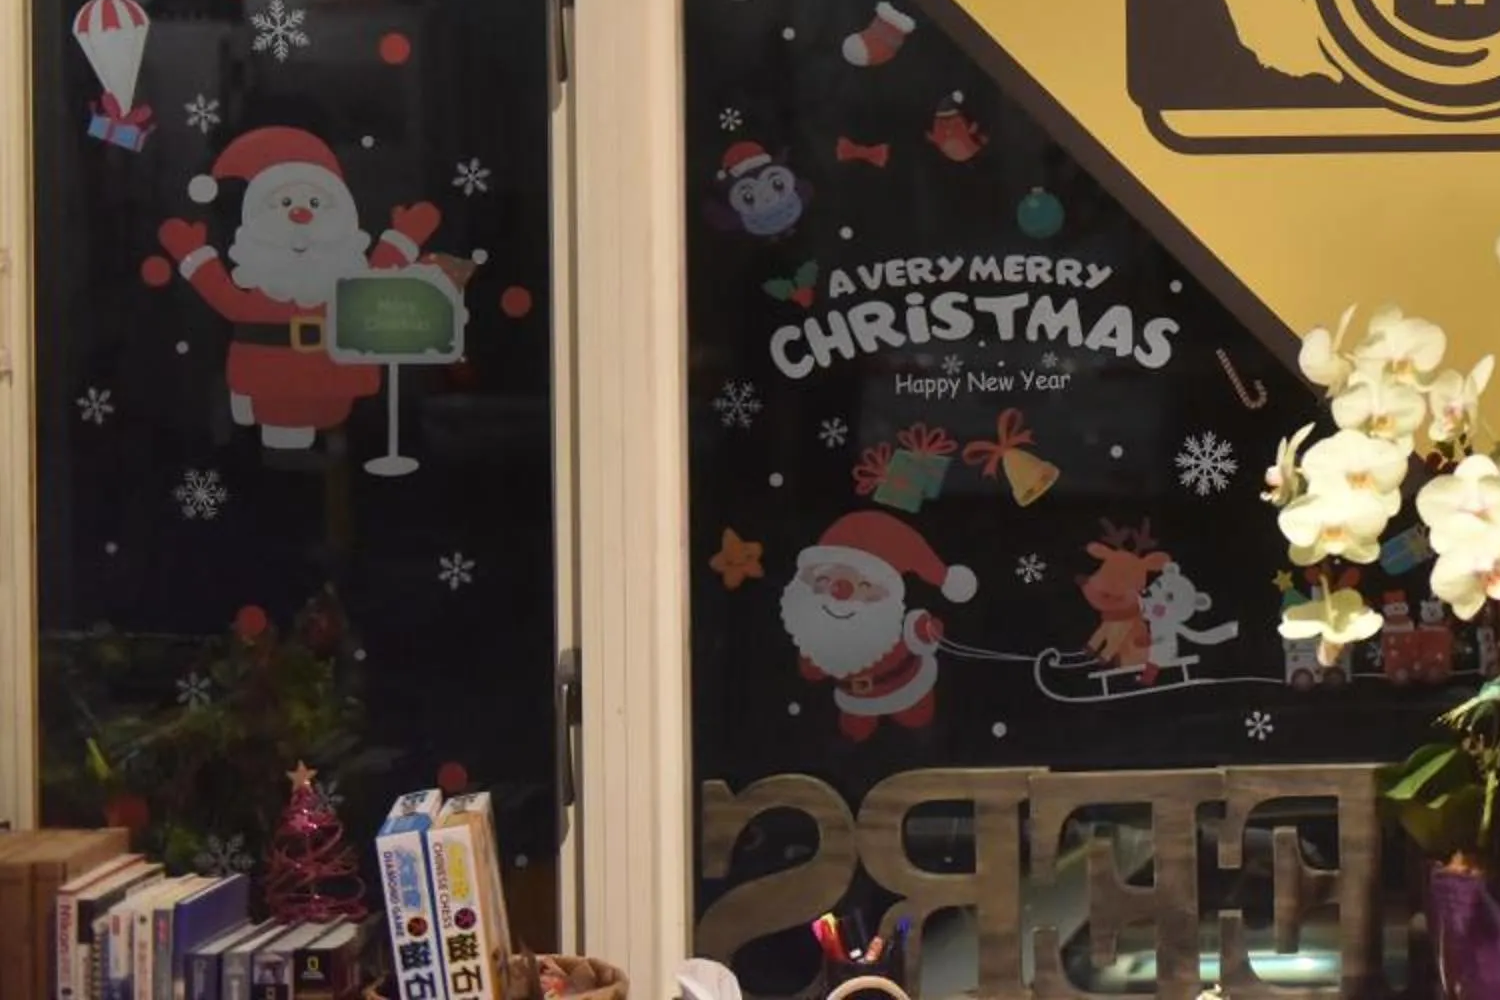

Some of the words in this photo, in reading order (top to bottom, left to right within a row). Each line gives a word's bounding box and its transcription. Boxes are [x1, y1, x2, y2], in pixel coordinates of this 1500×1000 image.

[829, 269, 857, 298] A
[858, 256, 964, 290] VERY
[968, 255, 1113, 289] MERRY
[895, 373, 960, 399] Happy
[967, 371, 1014, 392] New
[1019, 370, 1071, 391] Year
